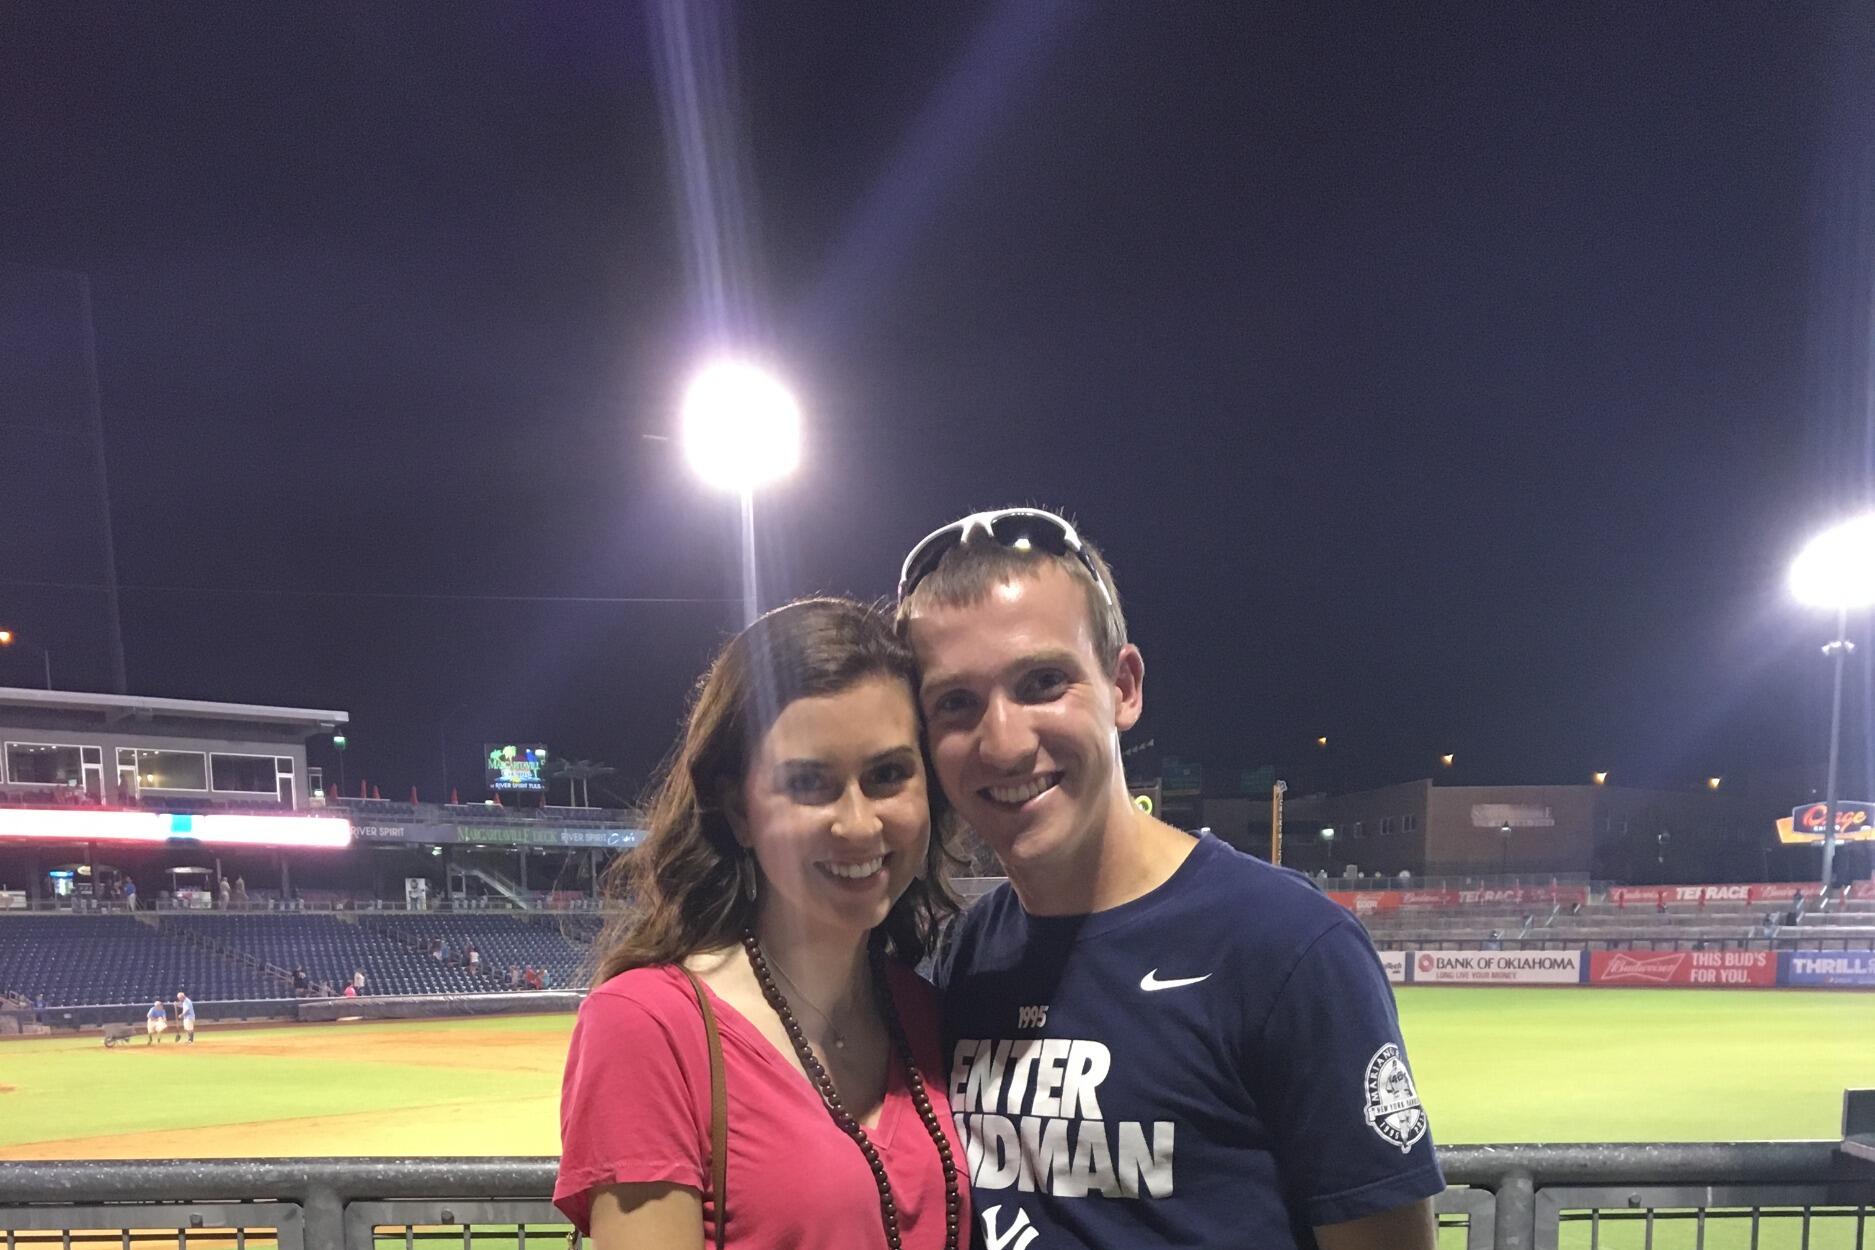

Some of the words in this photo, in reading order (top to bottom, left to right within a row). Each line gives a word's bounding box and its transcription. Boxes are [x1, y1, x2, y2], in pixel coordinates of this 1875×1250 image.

[379, 827, 405, 837] SPIRIT
[1436, 957, 1474, 970] BANK
[1477, 957, 1495, 970] OF
[1497, 957, 1576, 970] OKLAHOMA
[1691, 952, 1722, 966] THIS
[1726, 952, 1766, 966] BUD'S
[1609, 959, 1677, 974] Budweiser
[1691, 969, 1716, 983] FOR
[1720, 969, 1751, 983] YOU.
[1018, 1005, 1049, 1029] 1995
[951, 1038, 1111, 1120] ENTER
